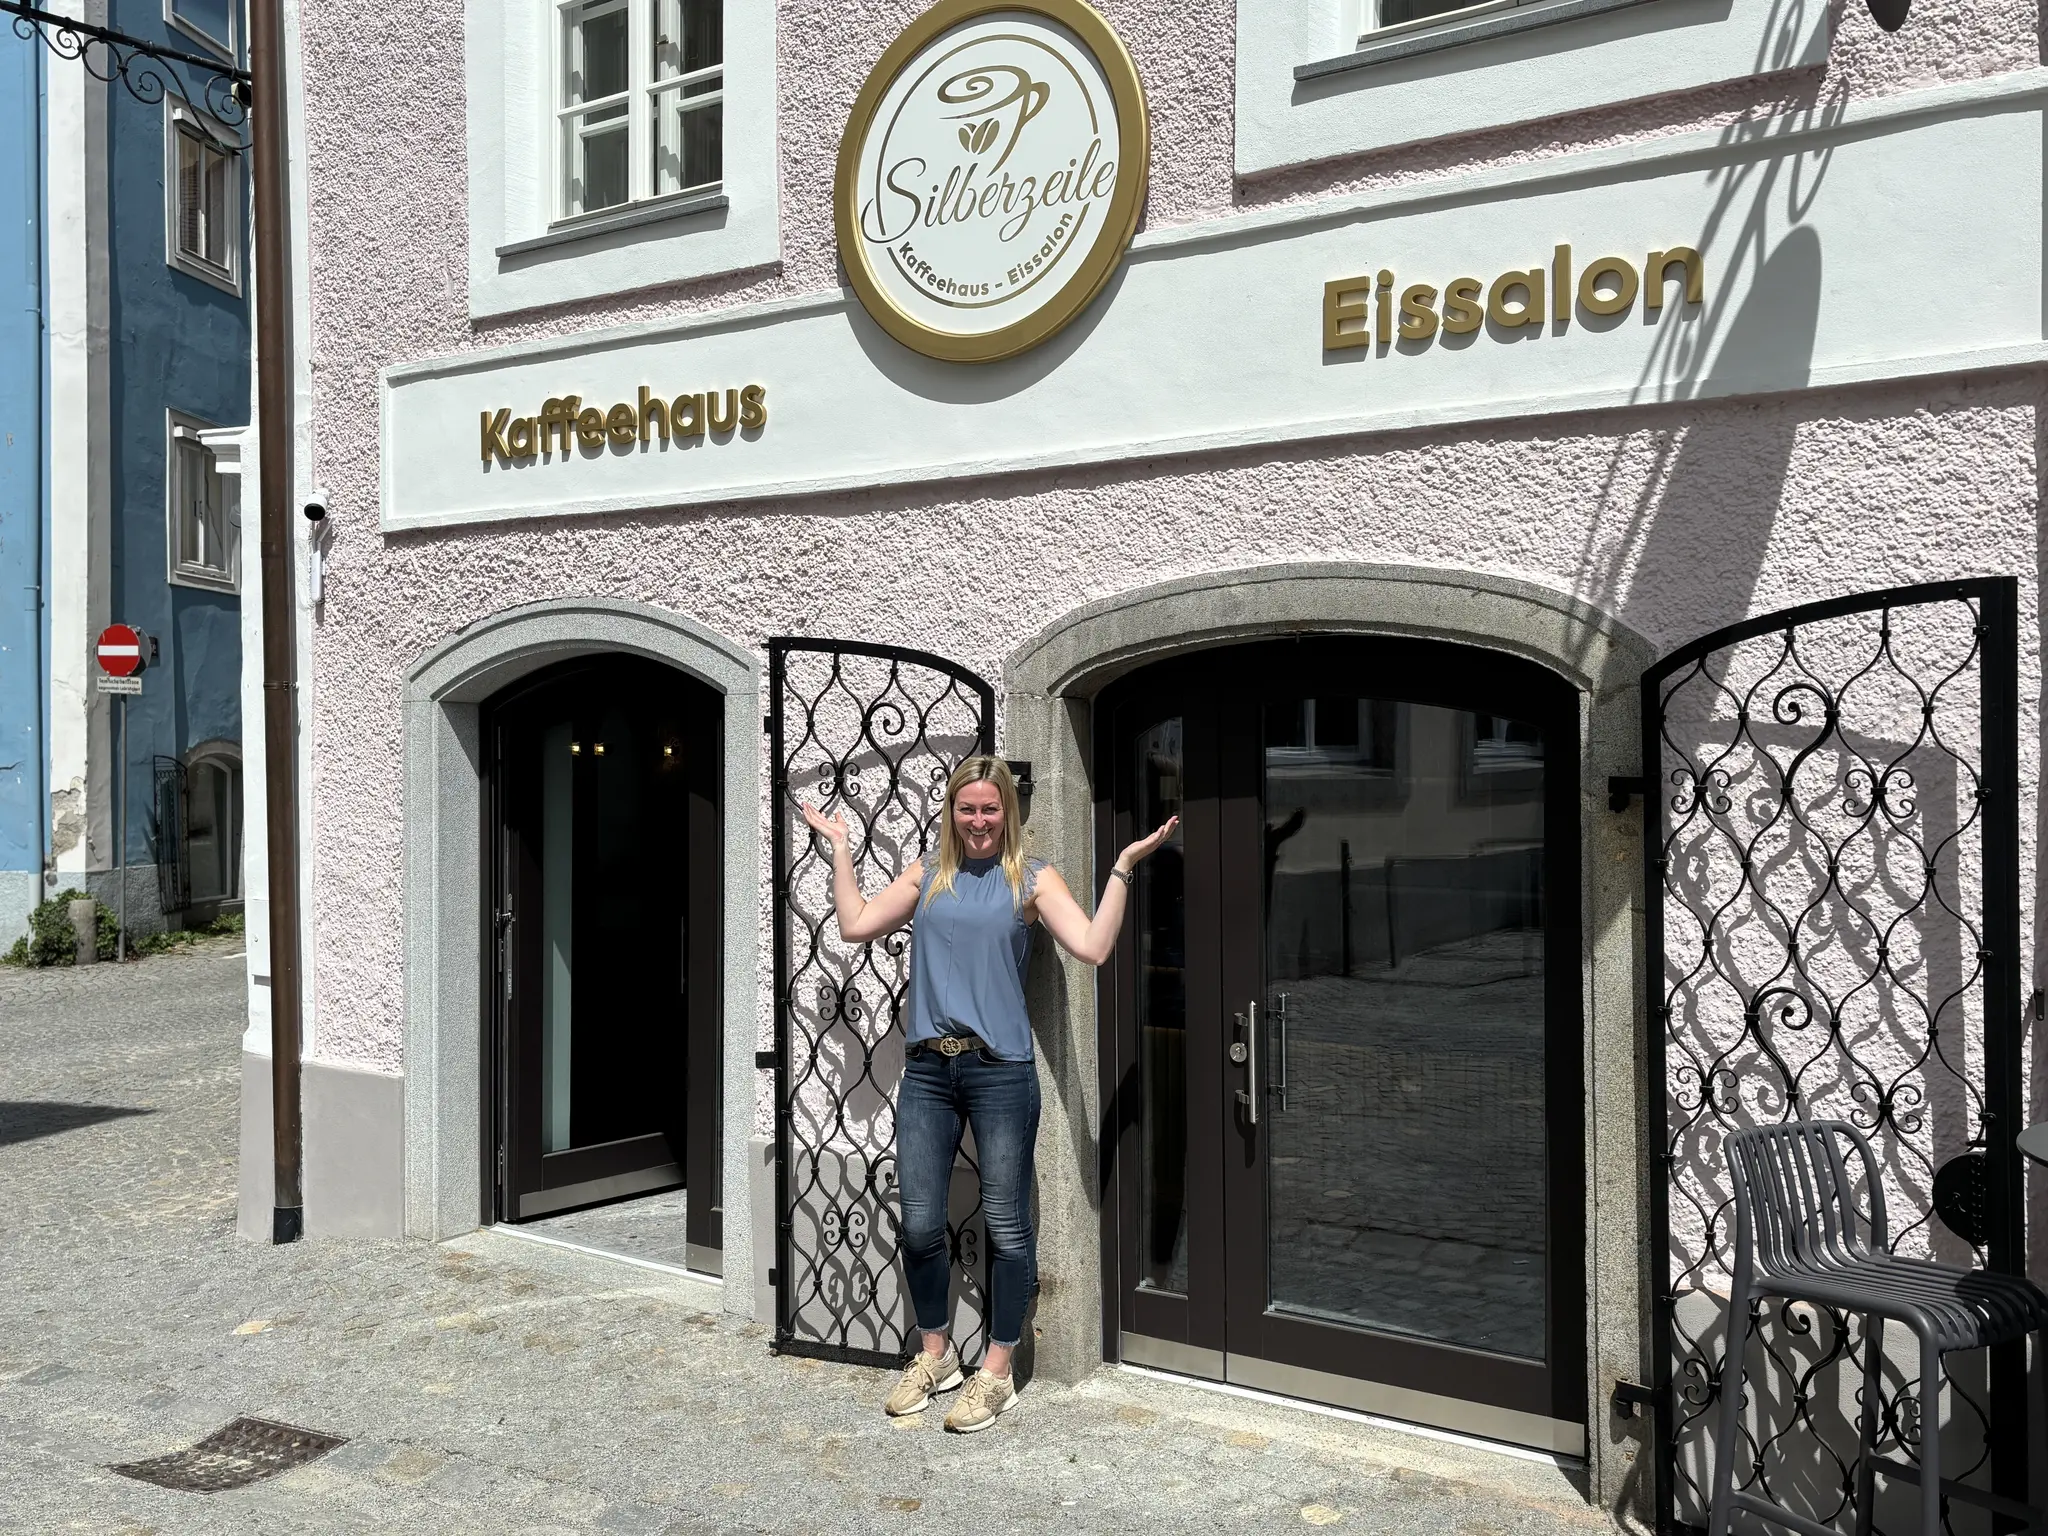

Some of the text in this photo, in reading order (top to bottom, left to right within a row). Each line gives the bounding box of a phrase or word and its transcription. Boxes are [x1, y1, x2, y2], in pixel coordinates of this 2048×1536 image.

[861, 137, 1116, 243] Silberzeile
[899, 241, 989, 297] Kaffeehaus
[1007, 212, 1073, 285] Eissalon
[1323, 243, 1704, 350] Eissalon
[480, 384, 767, 461] Kaffeehaus
